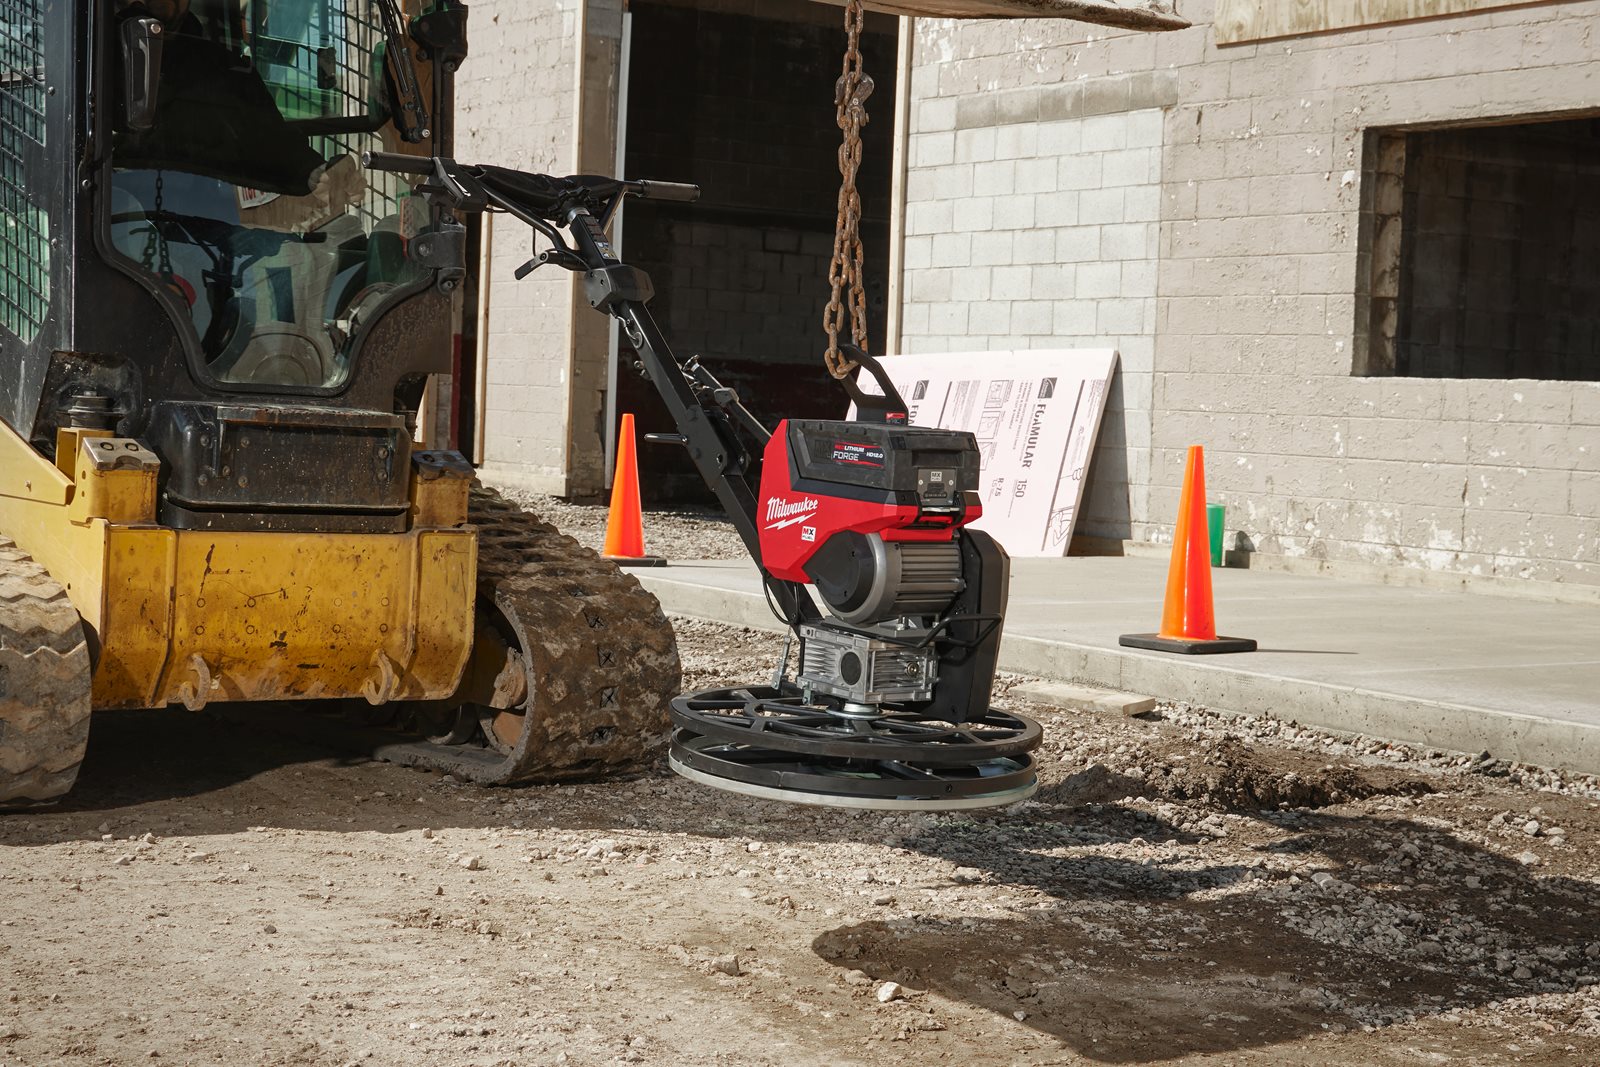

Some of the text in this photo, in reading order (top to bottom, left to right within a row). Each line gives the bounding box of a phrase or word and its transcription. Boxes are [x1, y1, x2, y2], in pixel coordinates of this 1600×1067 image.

[1022, 404, 1046, 467] FOAMULAR
[833, 450, 860, 461] FORGE
[1015, 479, 1027, 498] 150
[766, 496, 818, 522] Milwaukee
[803, 528, 814, 536] MX
